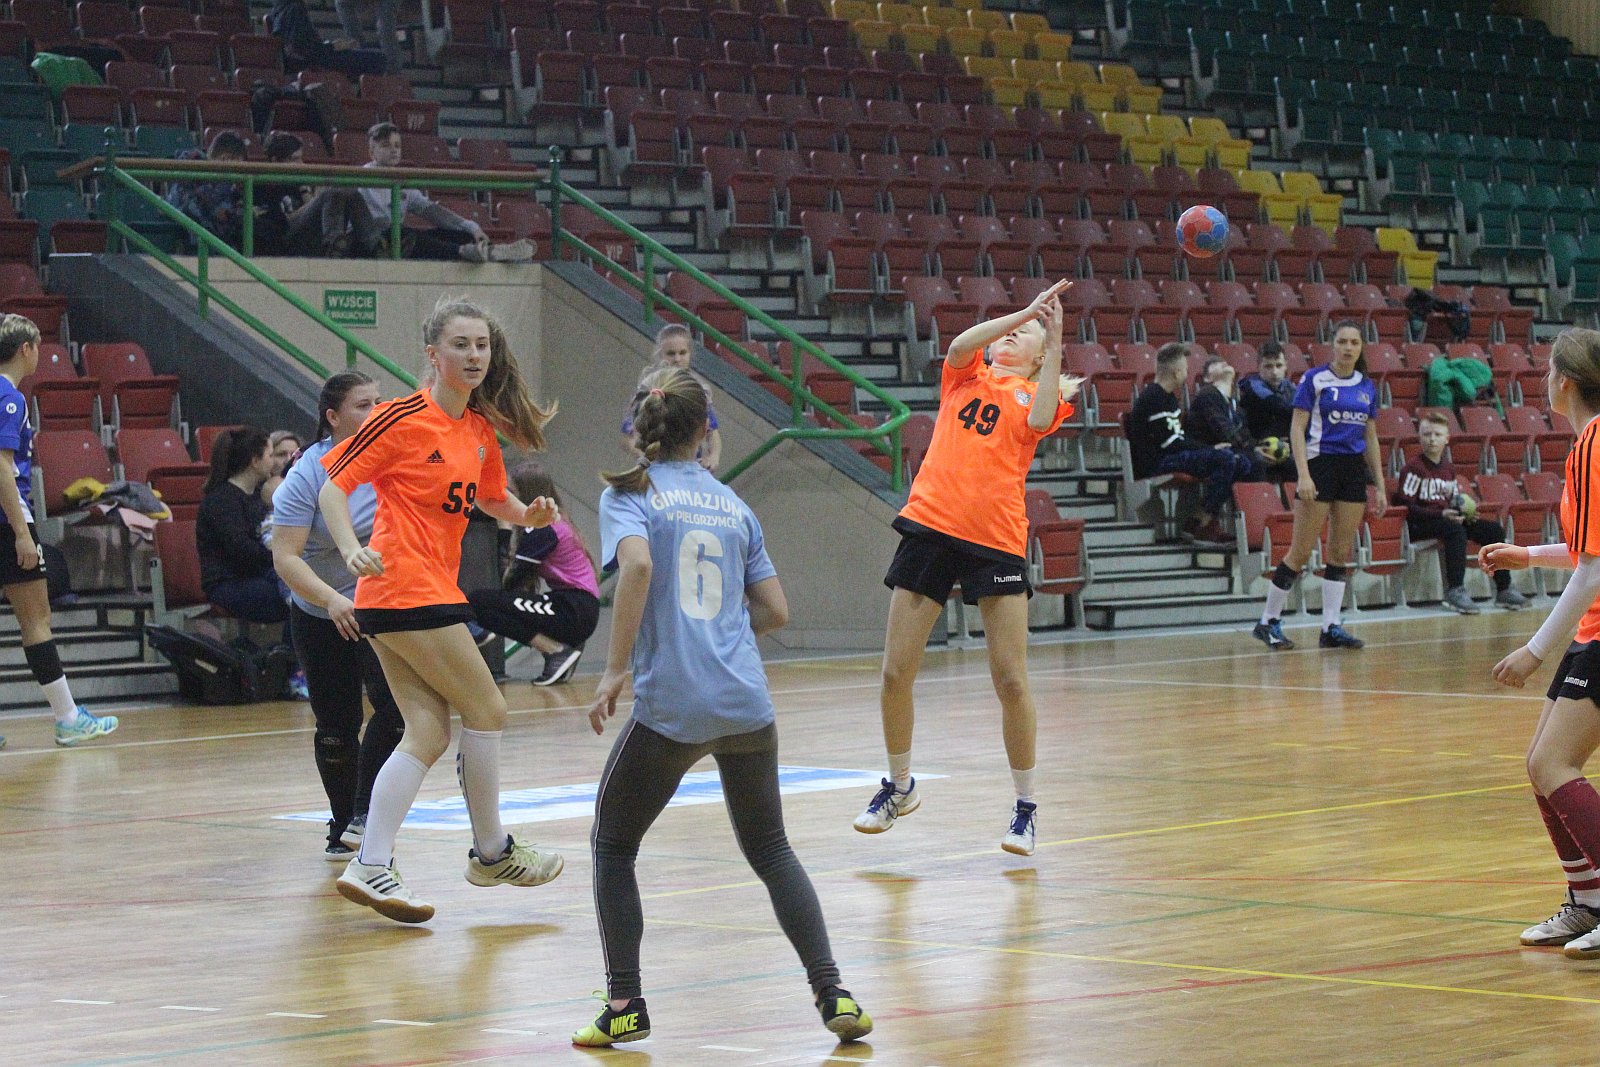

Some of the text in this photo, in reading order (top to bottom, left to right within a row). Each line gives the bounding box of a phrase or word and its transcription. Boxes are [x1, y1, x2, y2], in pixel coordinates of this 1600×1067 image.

[1331, 387, 1339, 401] 7
[958, 397, 1000, 436] 49
[441, 481, 477, 519] 59
[650, 489, 743, 522] GIMNAZJUM
[676, 510, 738, 528] PIELGRZYMCE
[679, 529, 723, 621] 6
[993, 573, 1023, 583] hummel
[1564, 675, 1589, 688] ummel
[610, 1012, 639, 1037] NIKE
